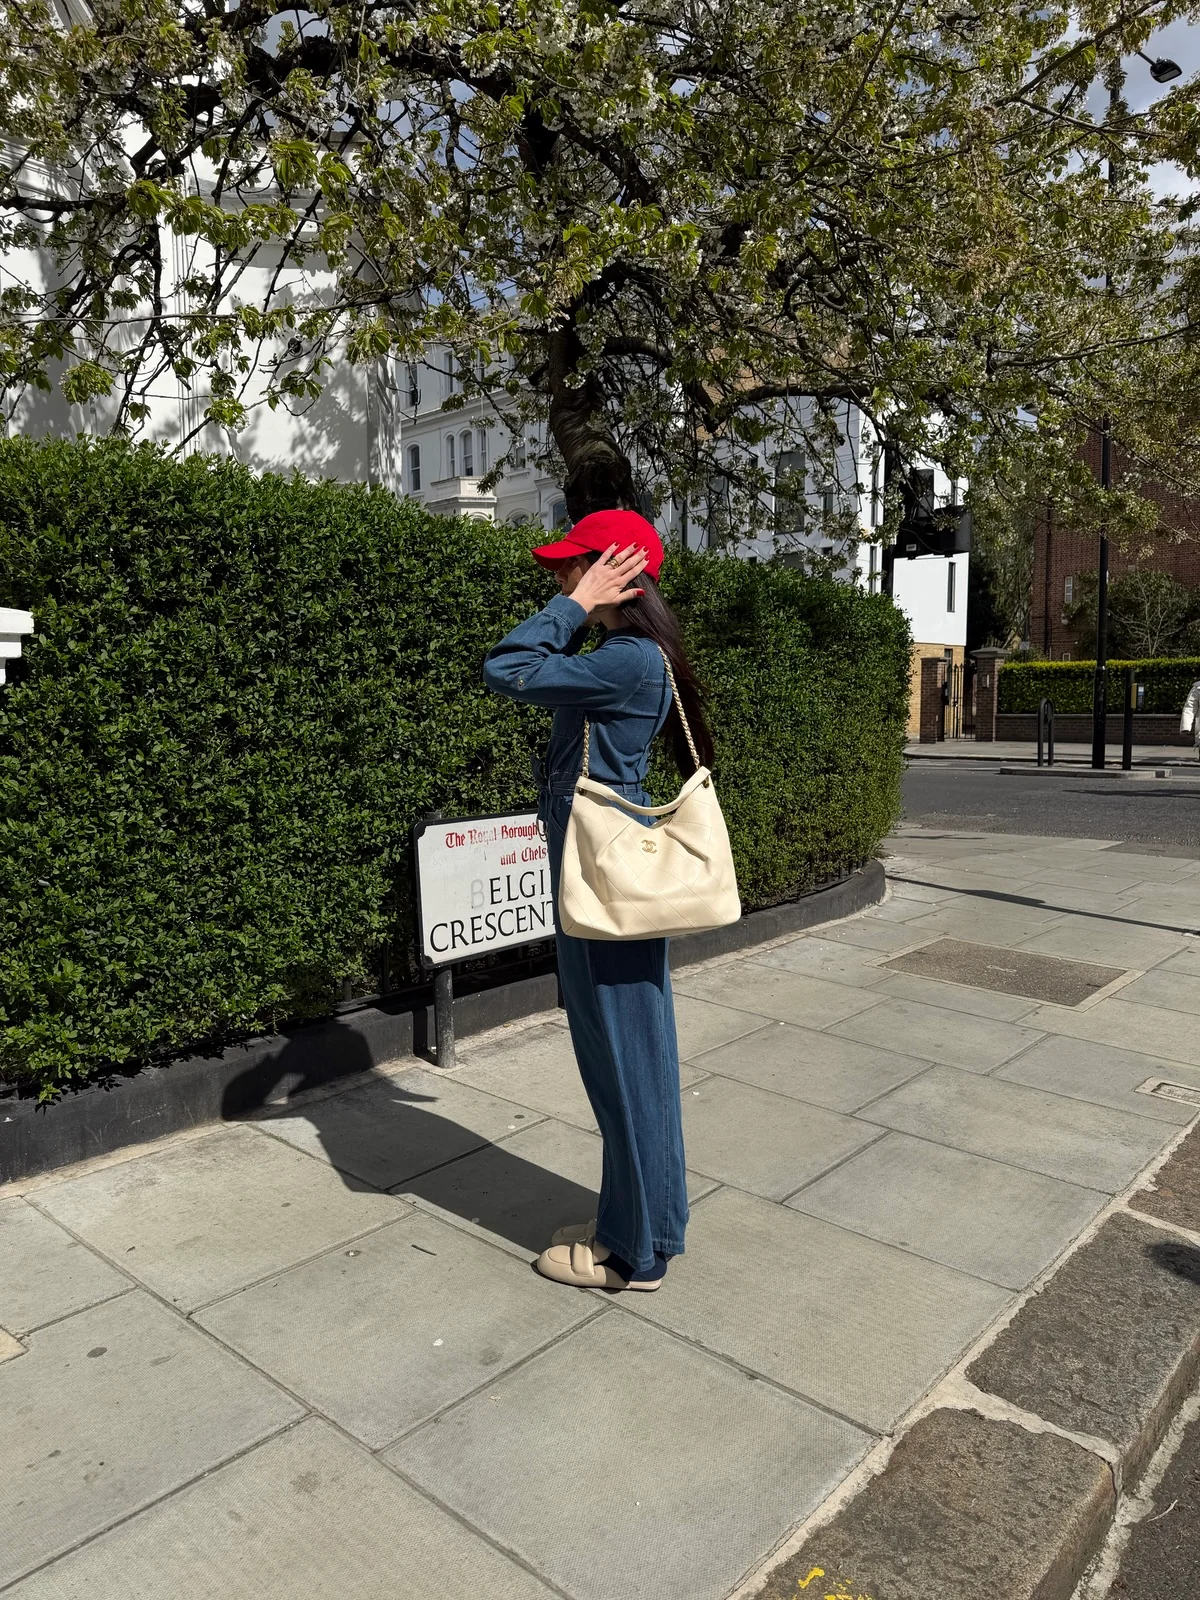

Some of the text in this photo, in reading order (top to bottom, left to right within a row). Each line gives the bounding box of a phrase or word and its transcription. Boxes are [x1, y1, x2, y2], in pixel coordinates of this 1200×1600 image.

[445, 832, 466, 848] The
[501, 822, 538, 841] Borough
[500, 845, 548, 865] and Chels
[470, 868, 552, 909] BELGI
